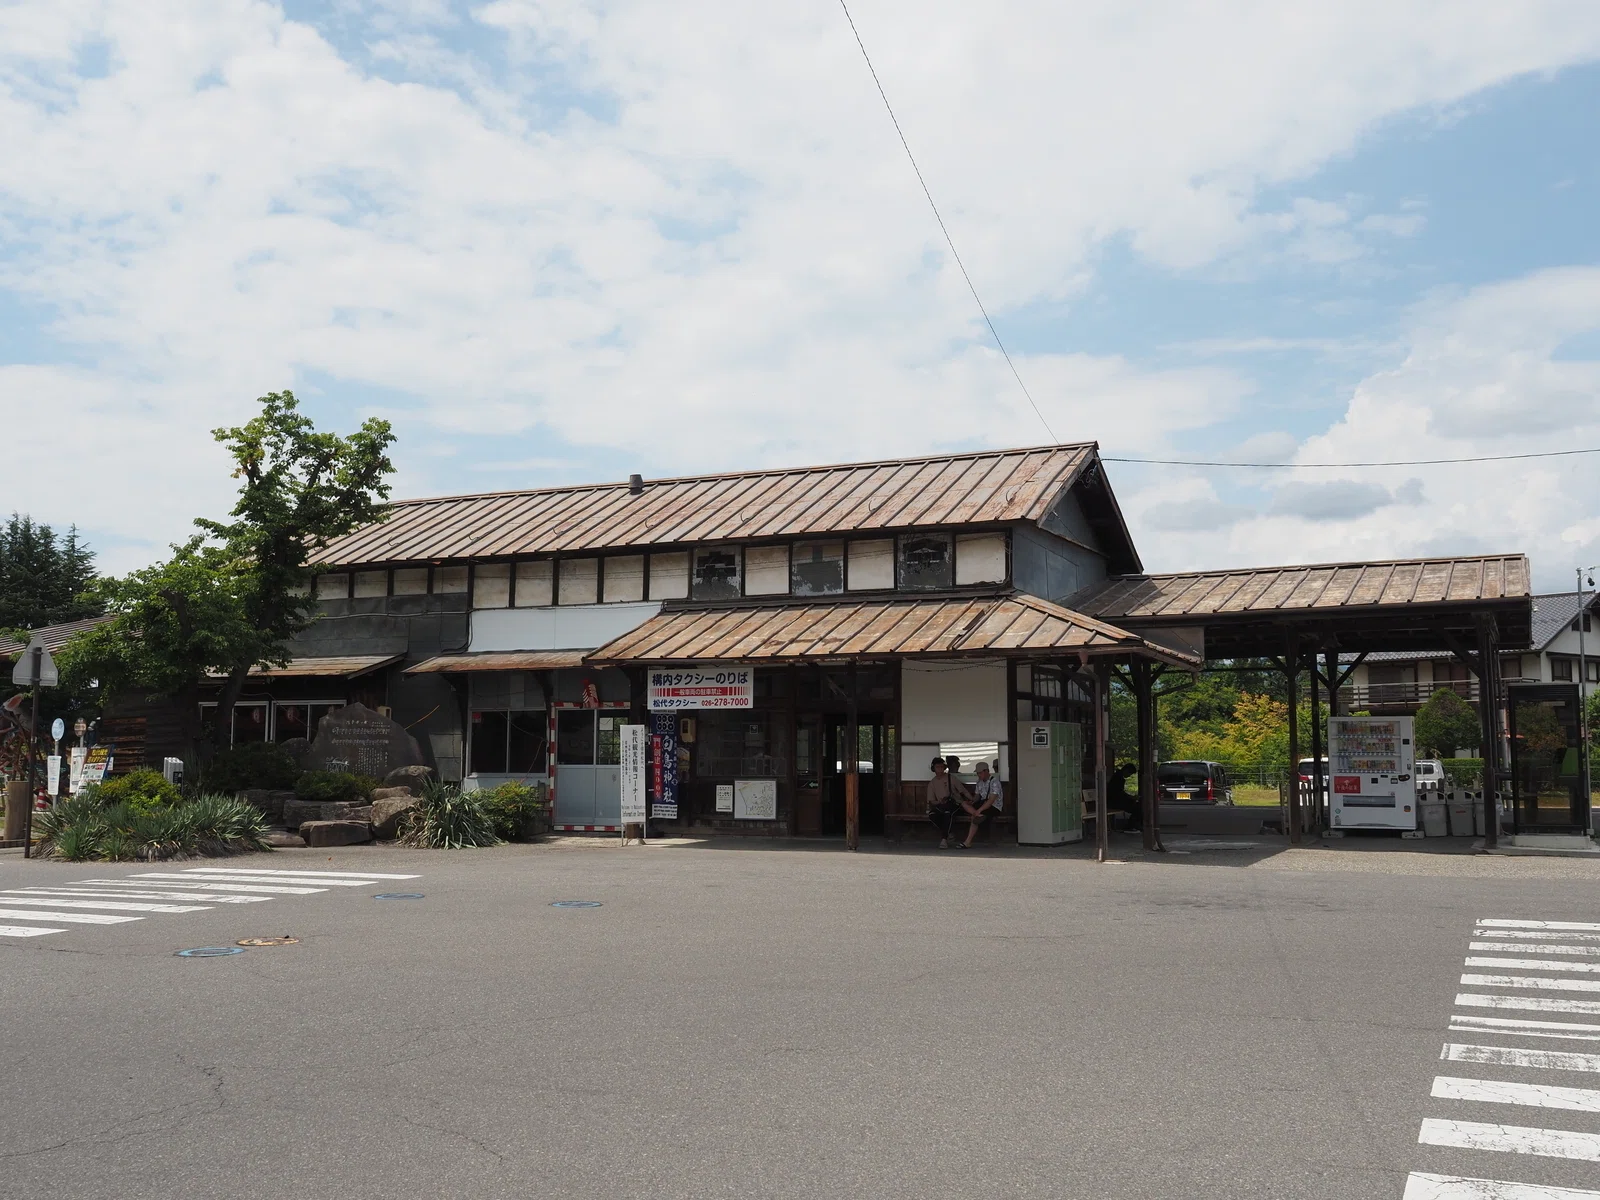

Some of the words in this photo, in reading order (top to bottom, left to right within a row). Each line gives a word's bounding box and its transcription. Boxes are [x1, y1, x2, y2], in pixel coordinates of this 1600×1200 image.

[652, 671, 748, 686] 構内タクシーのりば
[674, 688, 722, 696] 一般車両の駐車禁止
[653, 699, 697, 708] 松代タクシー
[701, 698, 749, 706] 026-278-7000
[663, 735, 675, 803] 白鳥神社
